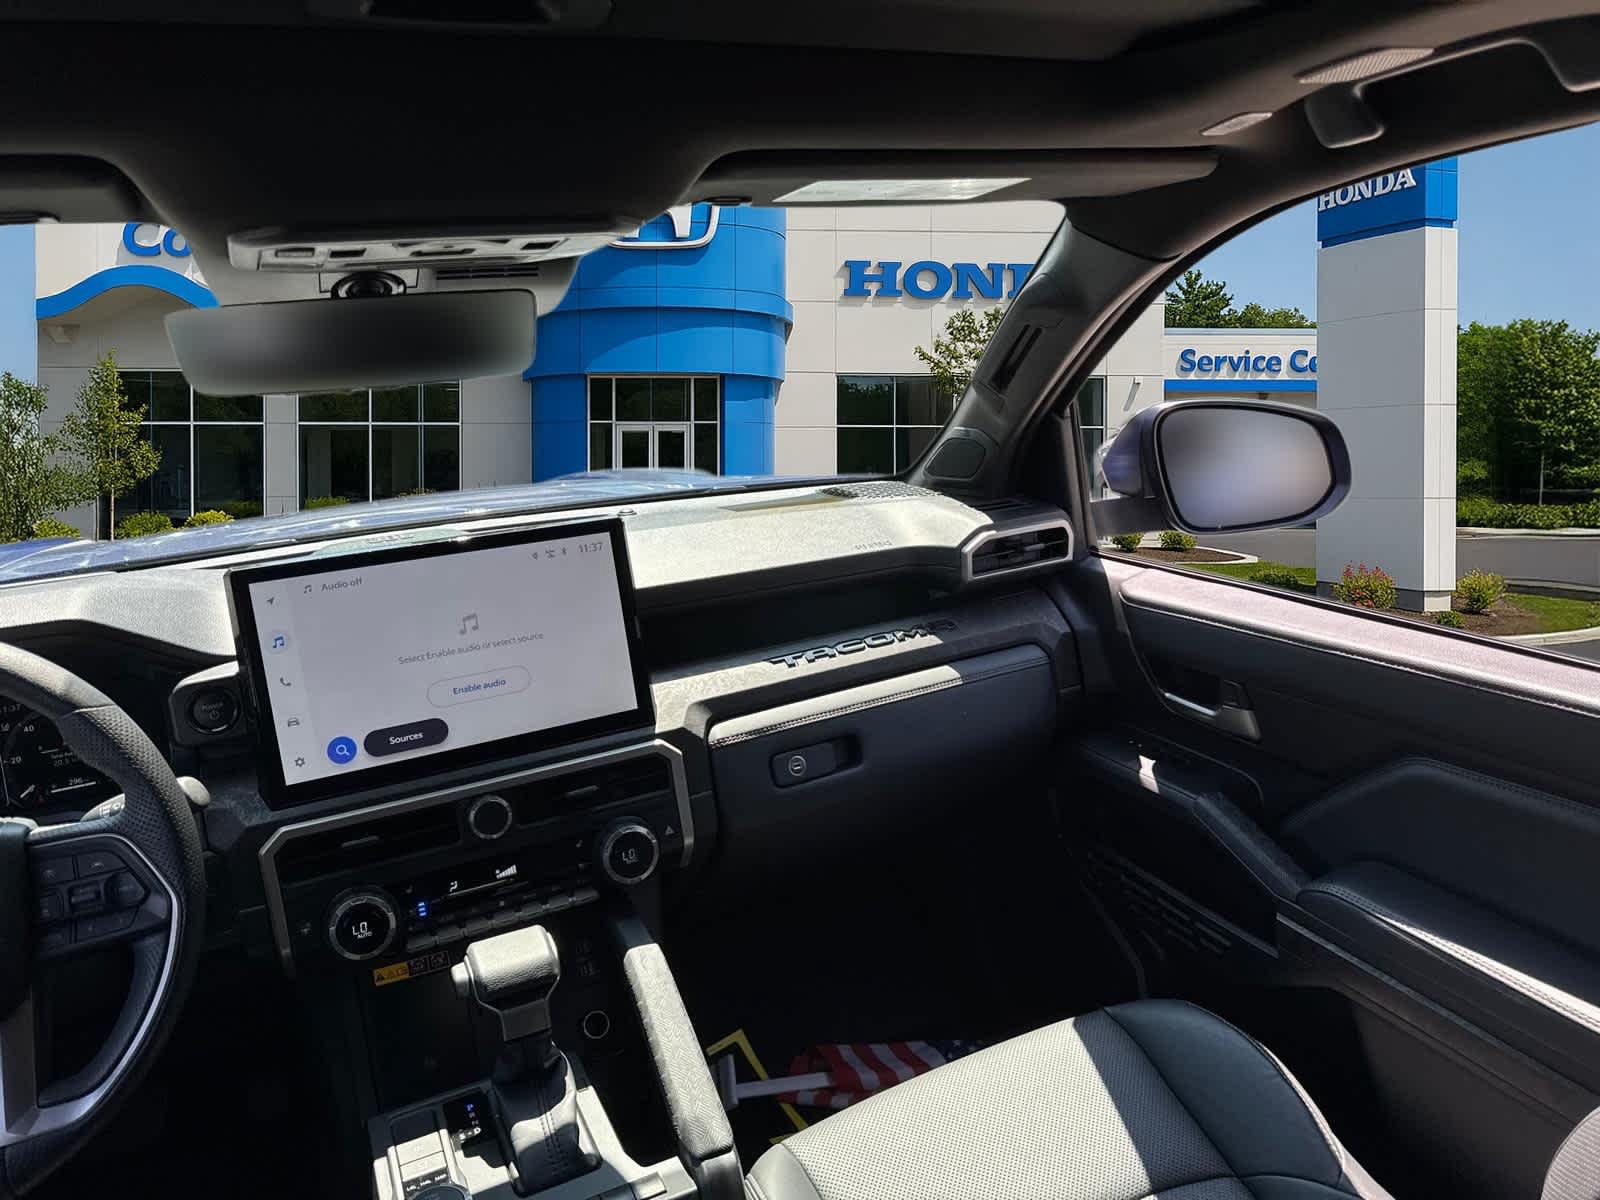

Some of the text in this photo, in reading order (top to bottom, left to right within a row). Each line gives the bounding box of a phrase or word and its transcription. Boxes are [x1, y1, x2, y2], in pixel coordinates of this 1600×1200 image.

[1318, 168, 1416, 212] HONDA
[1179, 348, 1282, 373] Service
[578, 542, 603, 554] 11:37
[321, 577, 363, 592] Audio off
[398, 653, 425, 665] Select
[426, 647, 456, 660] Enable
[457, 643, 481, 655] audio
[492, 637, 515, 648] select
[516, 632, 545, 643] source
[452, 678, 506, 696] Enable audio
[389, 732, 424, 745] Sources
